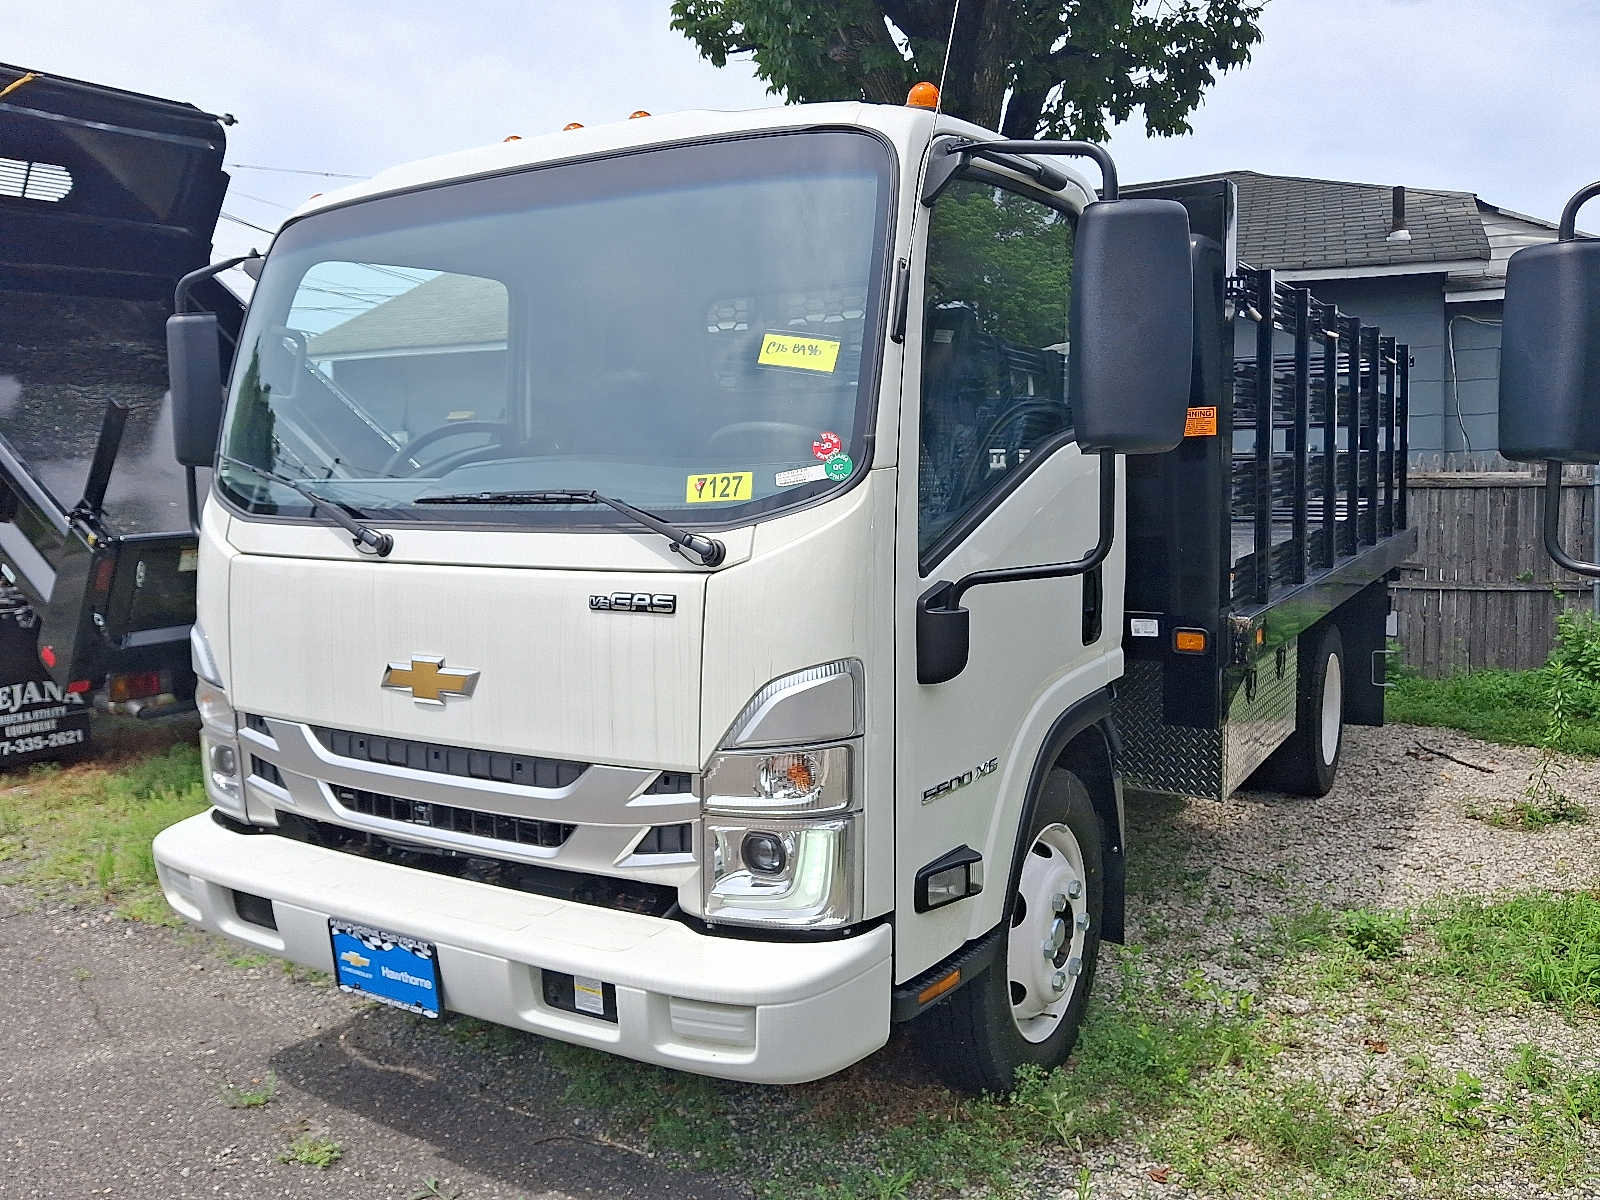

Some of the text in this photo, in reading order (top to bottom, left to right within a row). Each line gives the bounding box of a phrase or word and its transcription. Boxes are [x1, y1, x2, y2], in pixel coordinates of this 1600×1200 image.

[696, 475, 743, 498] 7127
[610, 592, 676, 613] GAS
[0, 729, 83, 756] 7-335-2621
[381, 965, 433, 990] Hawthorne
